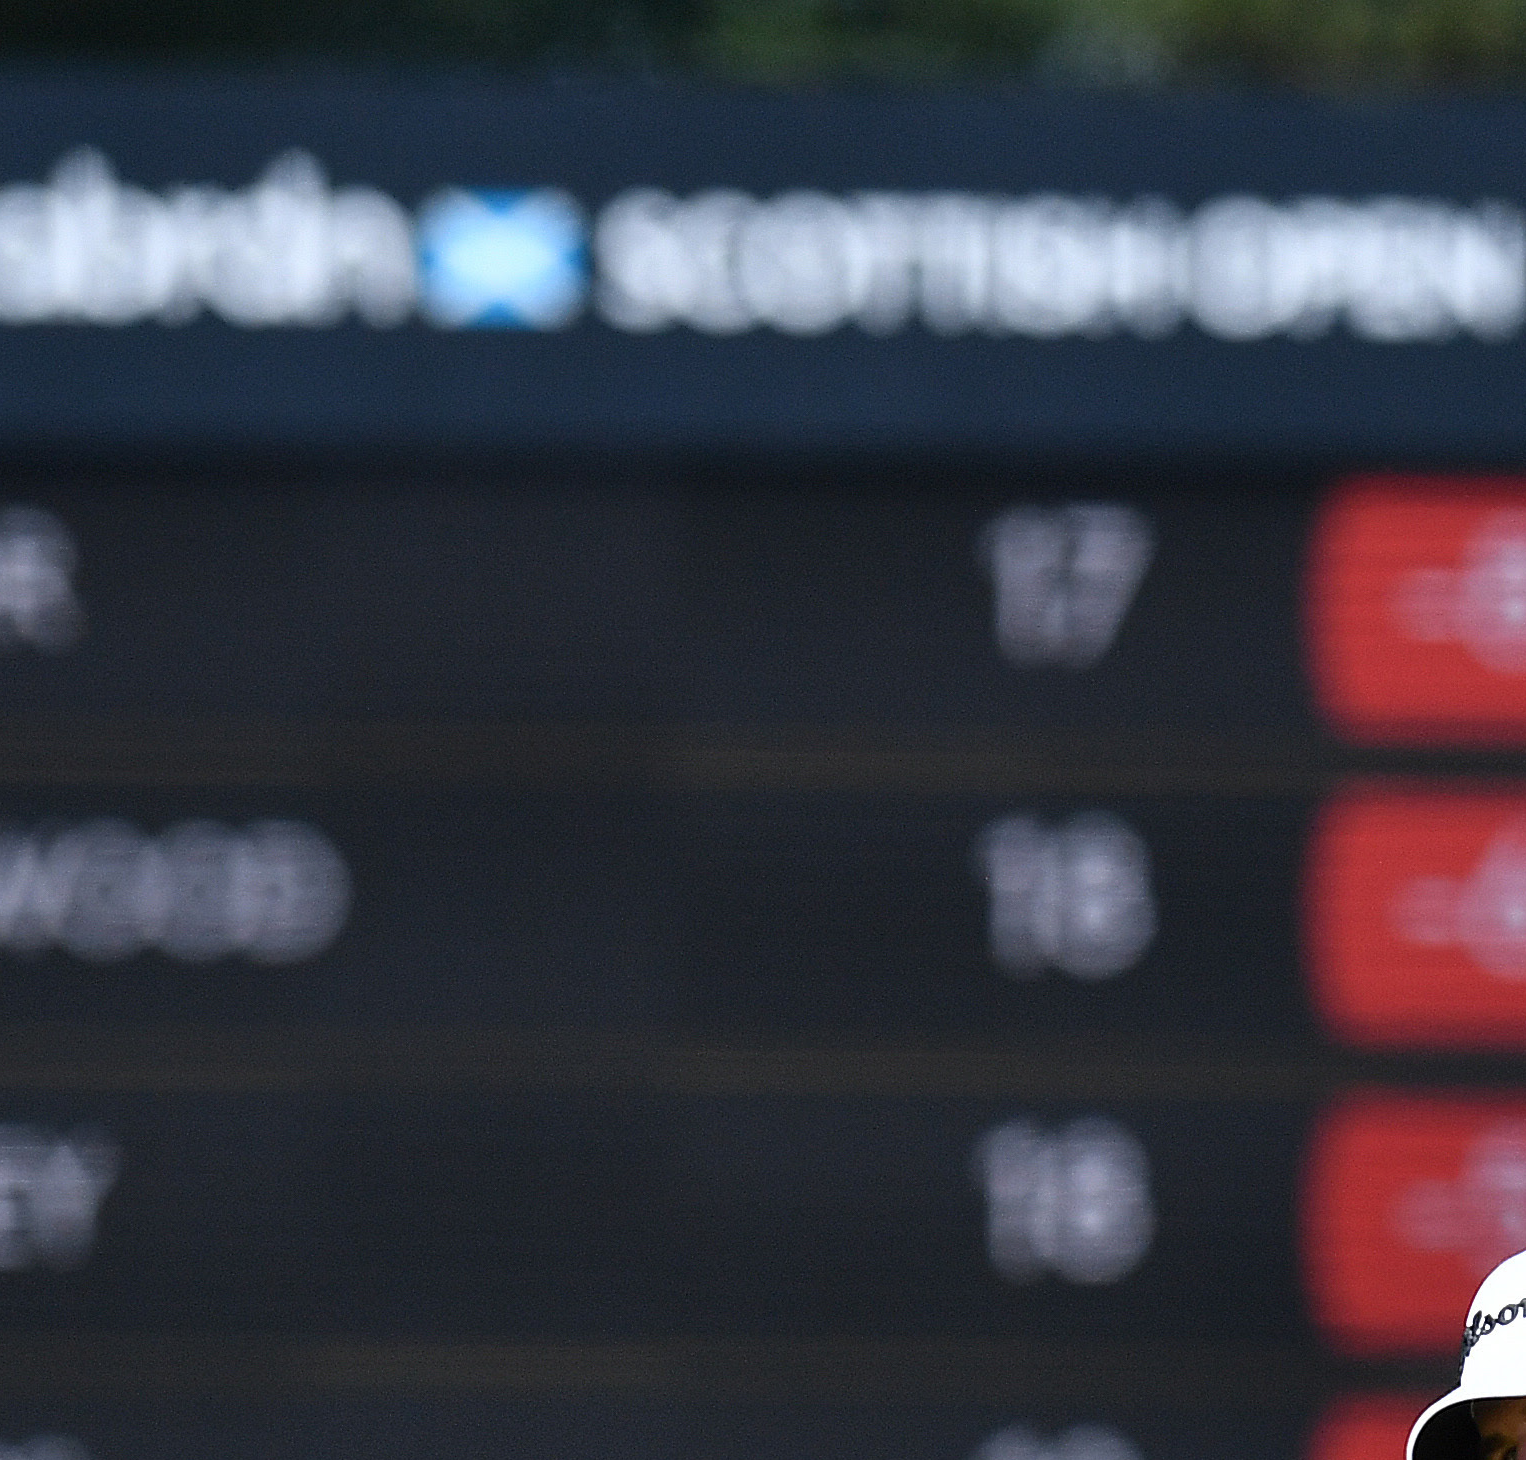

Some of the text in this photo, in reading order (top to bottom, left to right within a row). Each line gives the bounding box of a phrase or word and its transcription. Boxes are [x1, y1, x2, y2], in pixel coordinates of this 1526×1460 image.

[587, 188, 1183, 334] SCOTTISH
[983, 504, 1149, 664] 17
[982, 815, 1153, 978] 18
[979, 1120, 1153, 1284] 18
